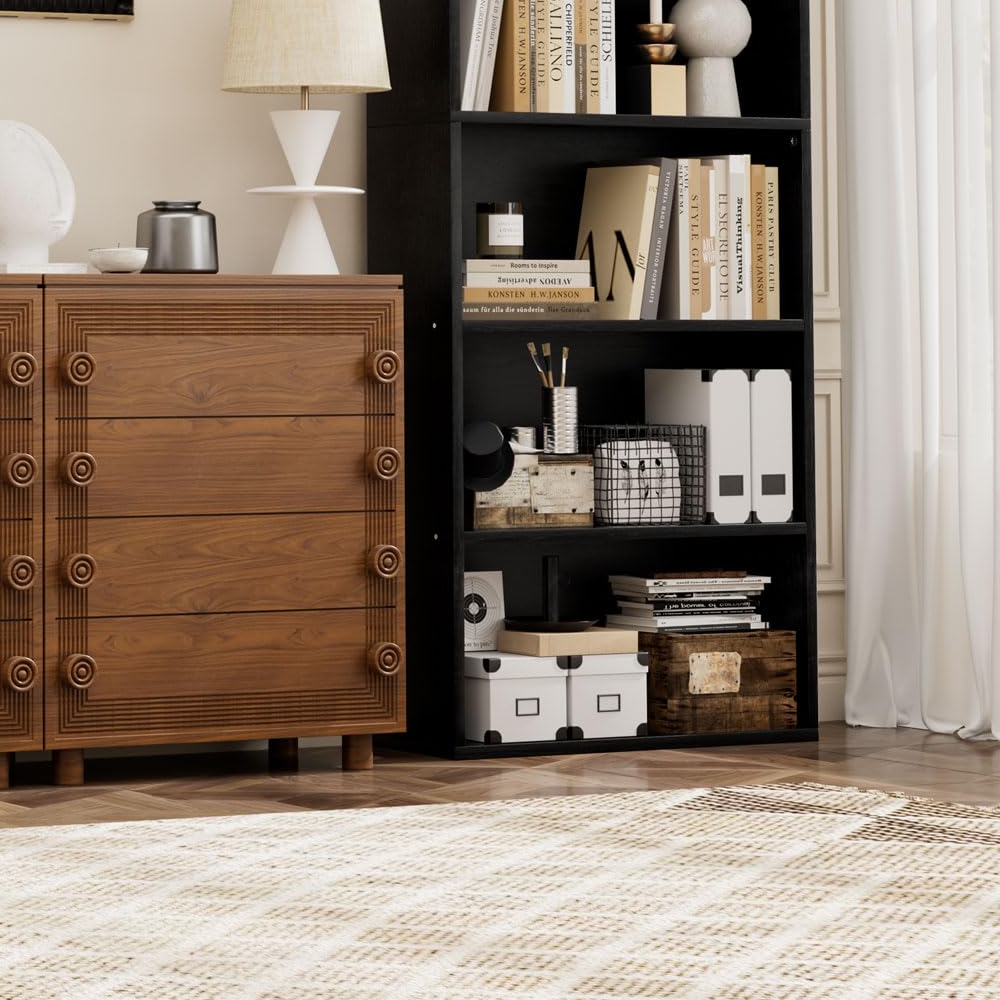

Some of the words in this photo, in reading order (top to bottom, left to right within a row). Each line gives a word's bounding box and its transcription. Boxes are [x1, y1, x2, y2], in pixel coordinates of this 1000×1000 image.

[489, 15, 499, 40] Joshua
[565, 3, 573, 66] CHIPPERFIELD
[537, 40, 545, 88] GUIDE
[590, 44, 599, 98] GUIDE
[662, 171, 671, 204] VICTORIA
[767, 181, 775, 214] PARIS
[691, 194, 699, 241] STYLE
[755, 191, 763, 236] KONSTEN
[538, 262, 558, 270] Inspire
[654, 237, 662, 267] INTERIOR
[497, 277, 537, 286] advertising
[539, 277, 572, 285] AVEDON
[691, 247, 700, 296] GUIDE
[488, 290, 525, 298] KONSTEN
[530, 290, 580, 298] H.W.JANSON
